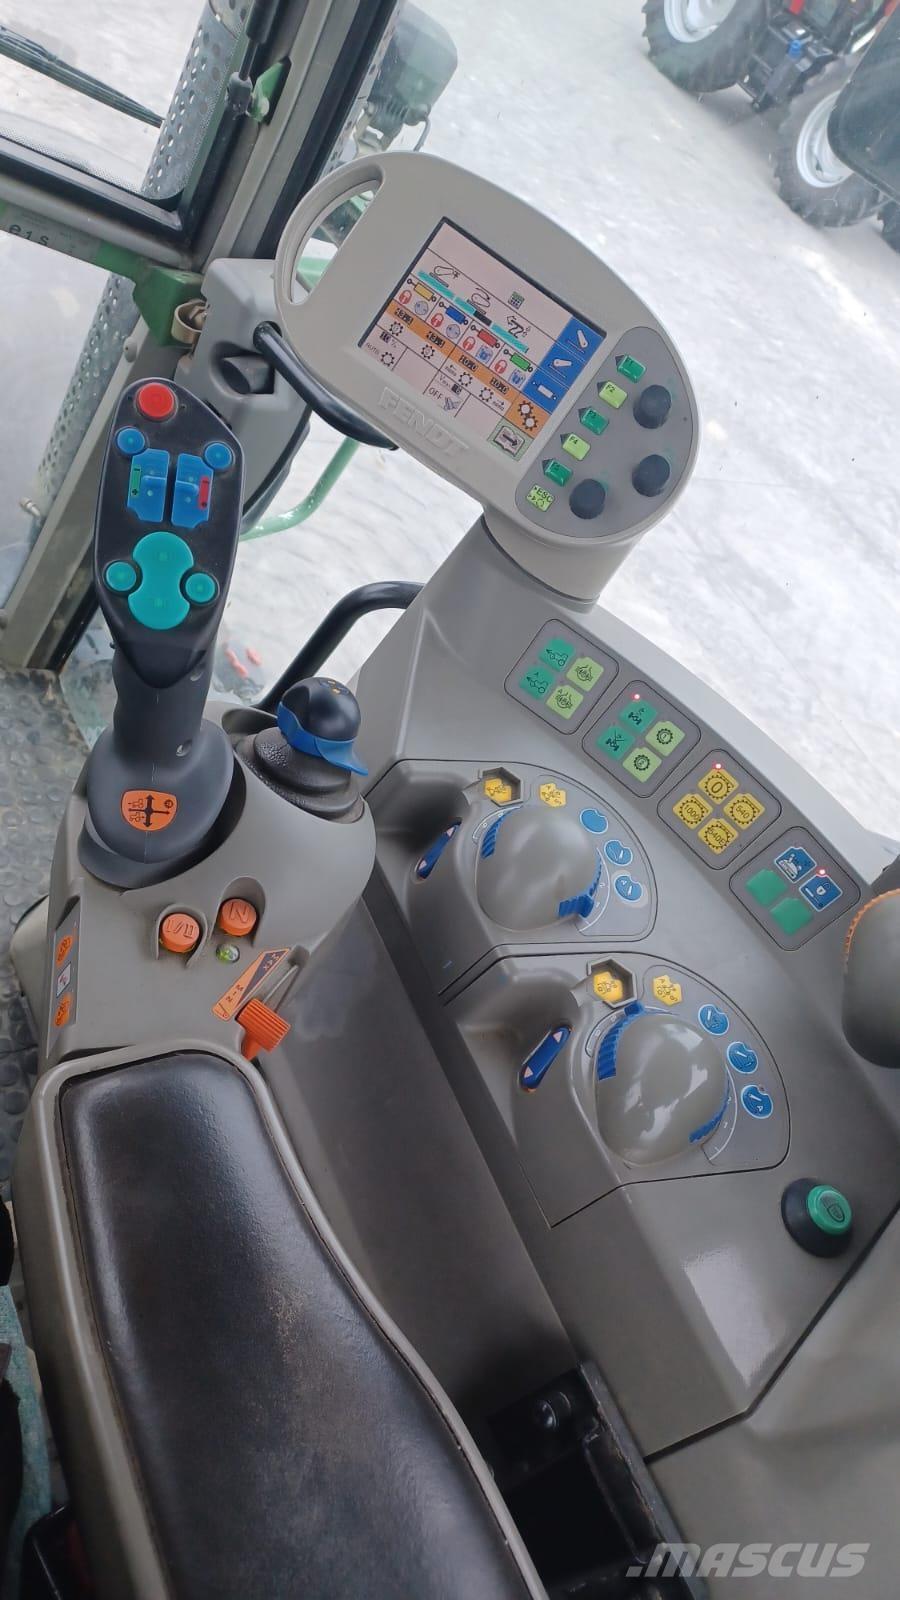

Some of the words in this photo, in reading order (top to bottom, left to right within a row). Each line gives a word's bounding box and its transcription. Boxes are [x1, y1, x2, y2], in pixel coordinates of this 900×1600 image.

[428, 387, 443, 399] OFF
[379, 386, 470, 456] FENDT
[684, 804, 700, 820] 1000
[735, 805, 750, 819] 540
[707, 828, 726, 846] 540E
